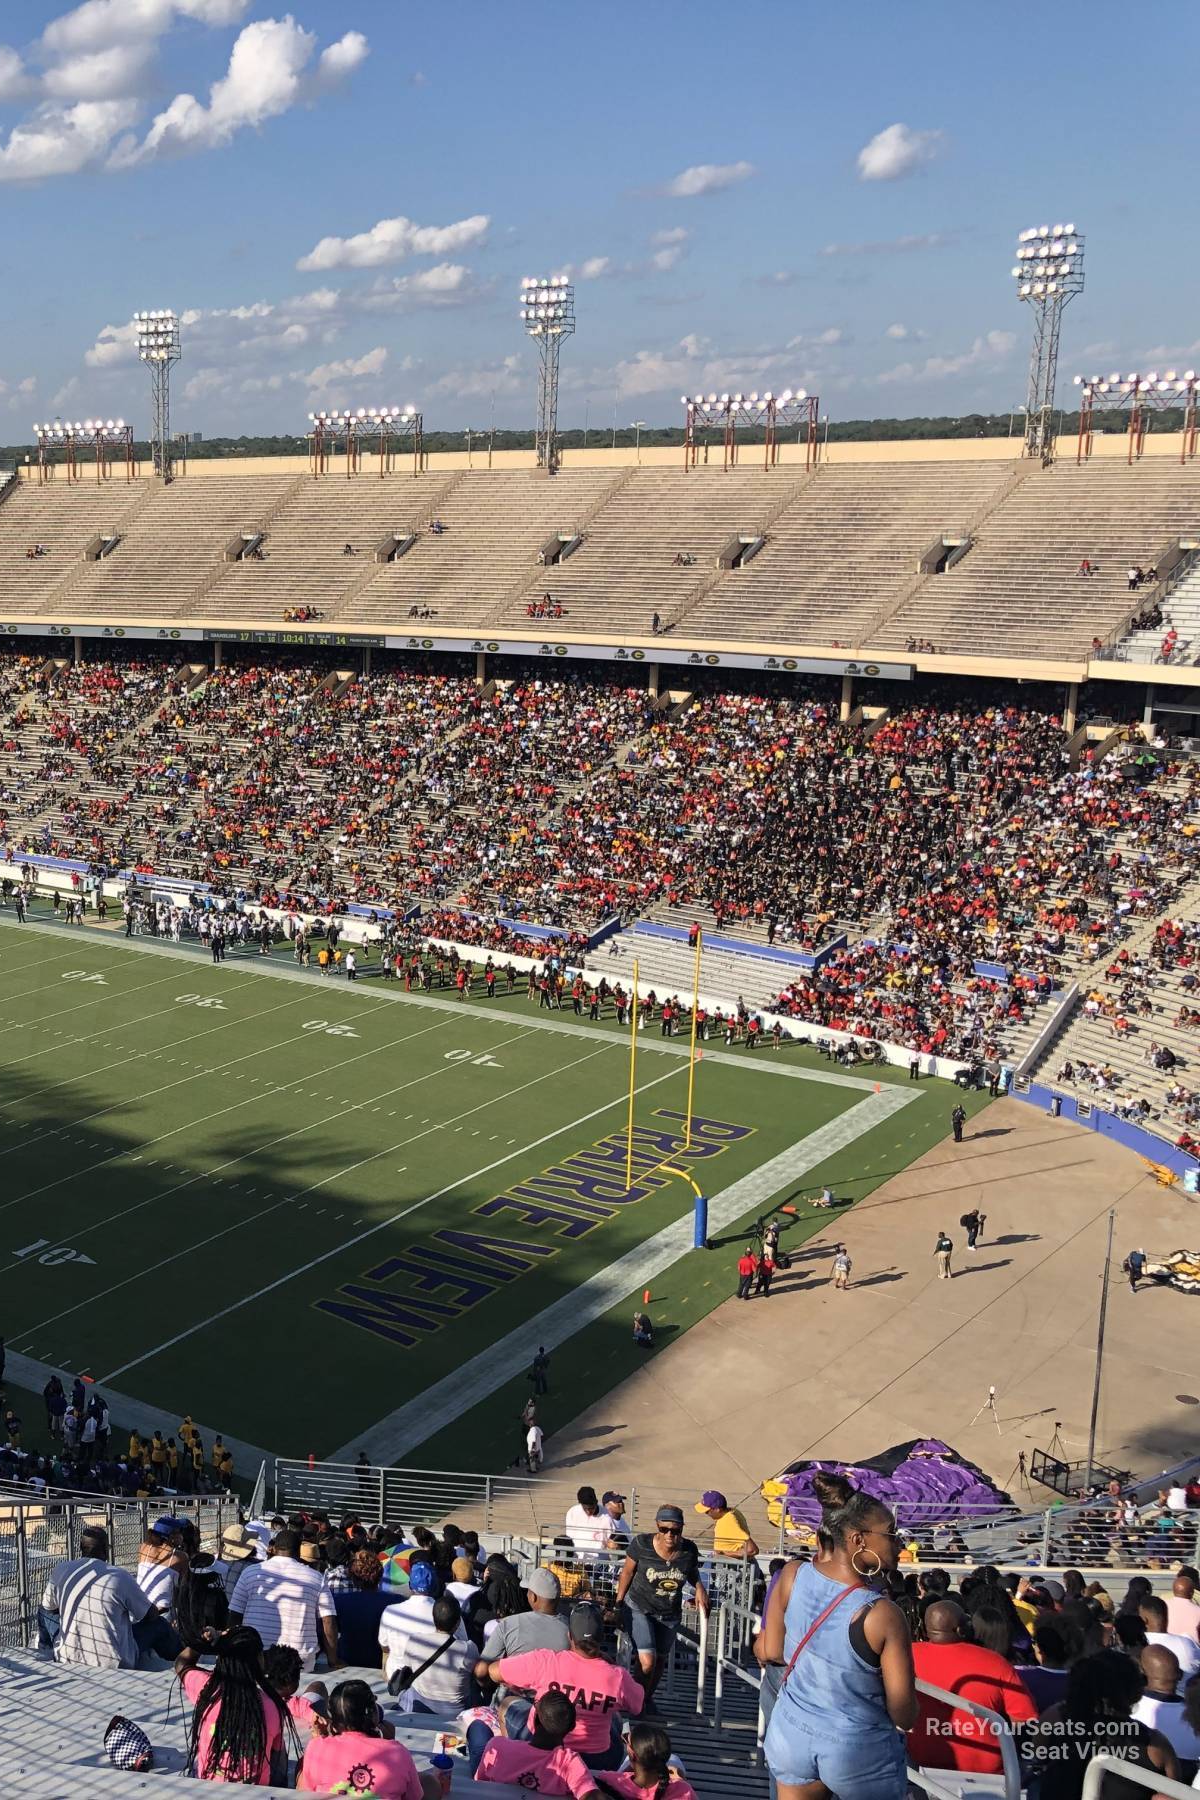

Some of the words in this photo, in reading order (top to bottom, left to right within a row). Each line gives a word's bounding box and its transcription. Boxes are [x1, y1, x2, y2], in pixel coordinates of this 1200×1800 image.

[240, 632, 250, 641] 17
[282, 634, 304, 643] 10:14
[336, 636, 346, 645] 14
[300, 1020, 357, 1036] 20
[443, 1048, 497, 1067] 10
[469, 1107, 759, 1241] PRAIRIE
[12, 1238, 77, 1266] 10
[310, 1228, 562, 1350] VIEW
